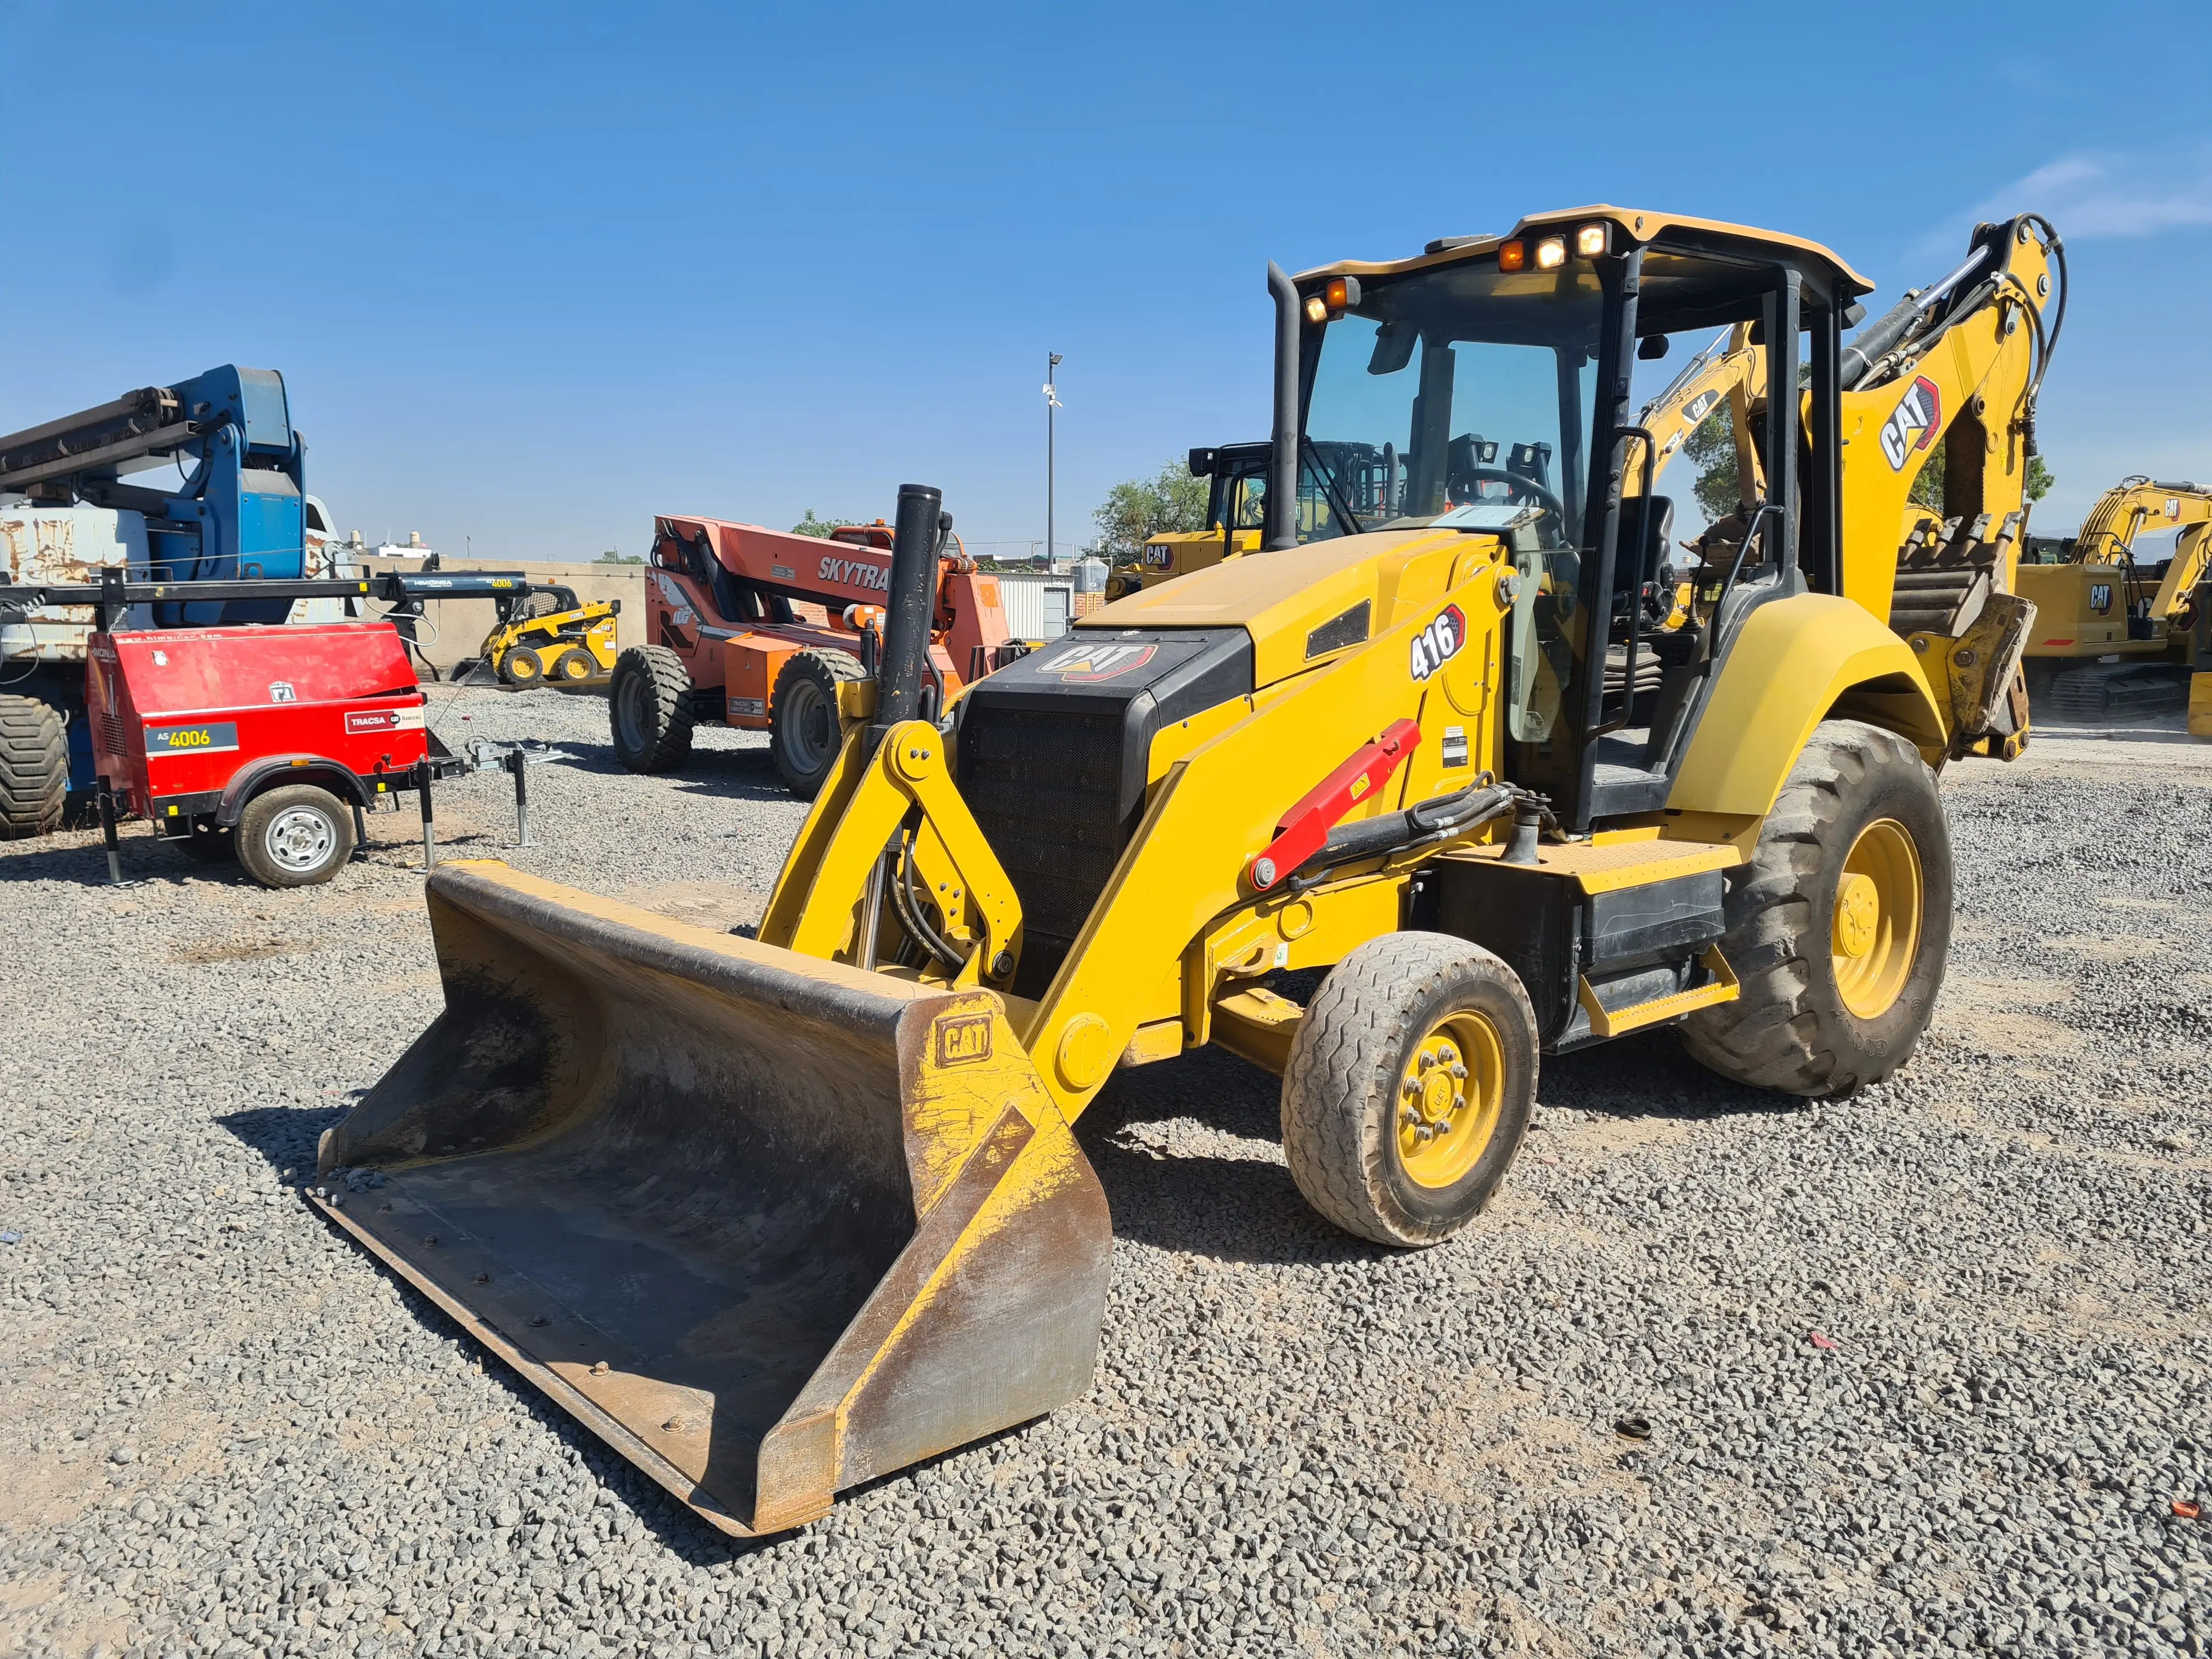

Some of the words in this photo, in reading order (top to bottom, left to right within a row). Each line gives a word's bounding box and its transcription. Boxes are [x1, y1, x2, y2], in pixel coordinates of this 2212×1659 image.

[1691, 393, 1708, 418] CAT
[1881, 382, 1929, 469] CAT
[2165, 499, 2178, 517] CAT
[1146, 545, 1167, 565] CAT
[492, 578, 512, 588] 4006
[817, 556, 890, 592] SKYTRA
[2090, 585, 2109, 608] CAT
[1412, 614, 1455, 677] 416
[1041, 645, 1146, 673] CAT
[351, 716, 386, 726] TRACSA
[157, 732, 169, 741] AS
[169, 730, 210, 747] 4006
[945, 1023, 986, 1059] CAT
